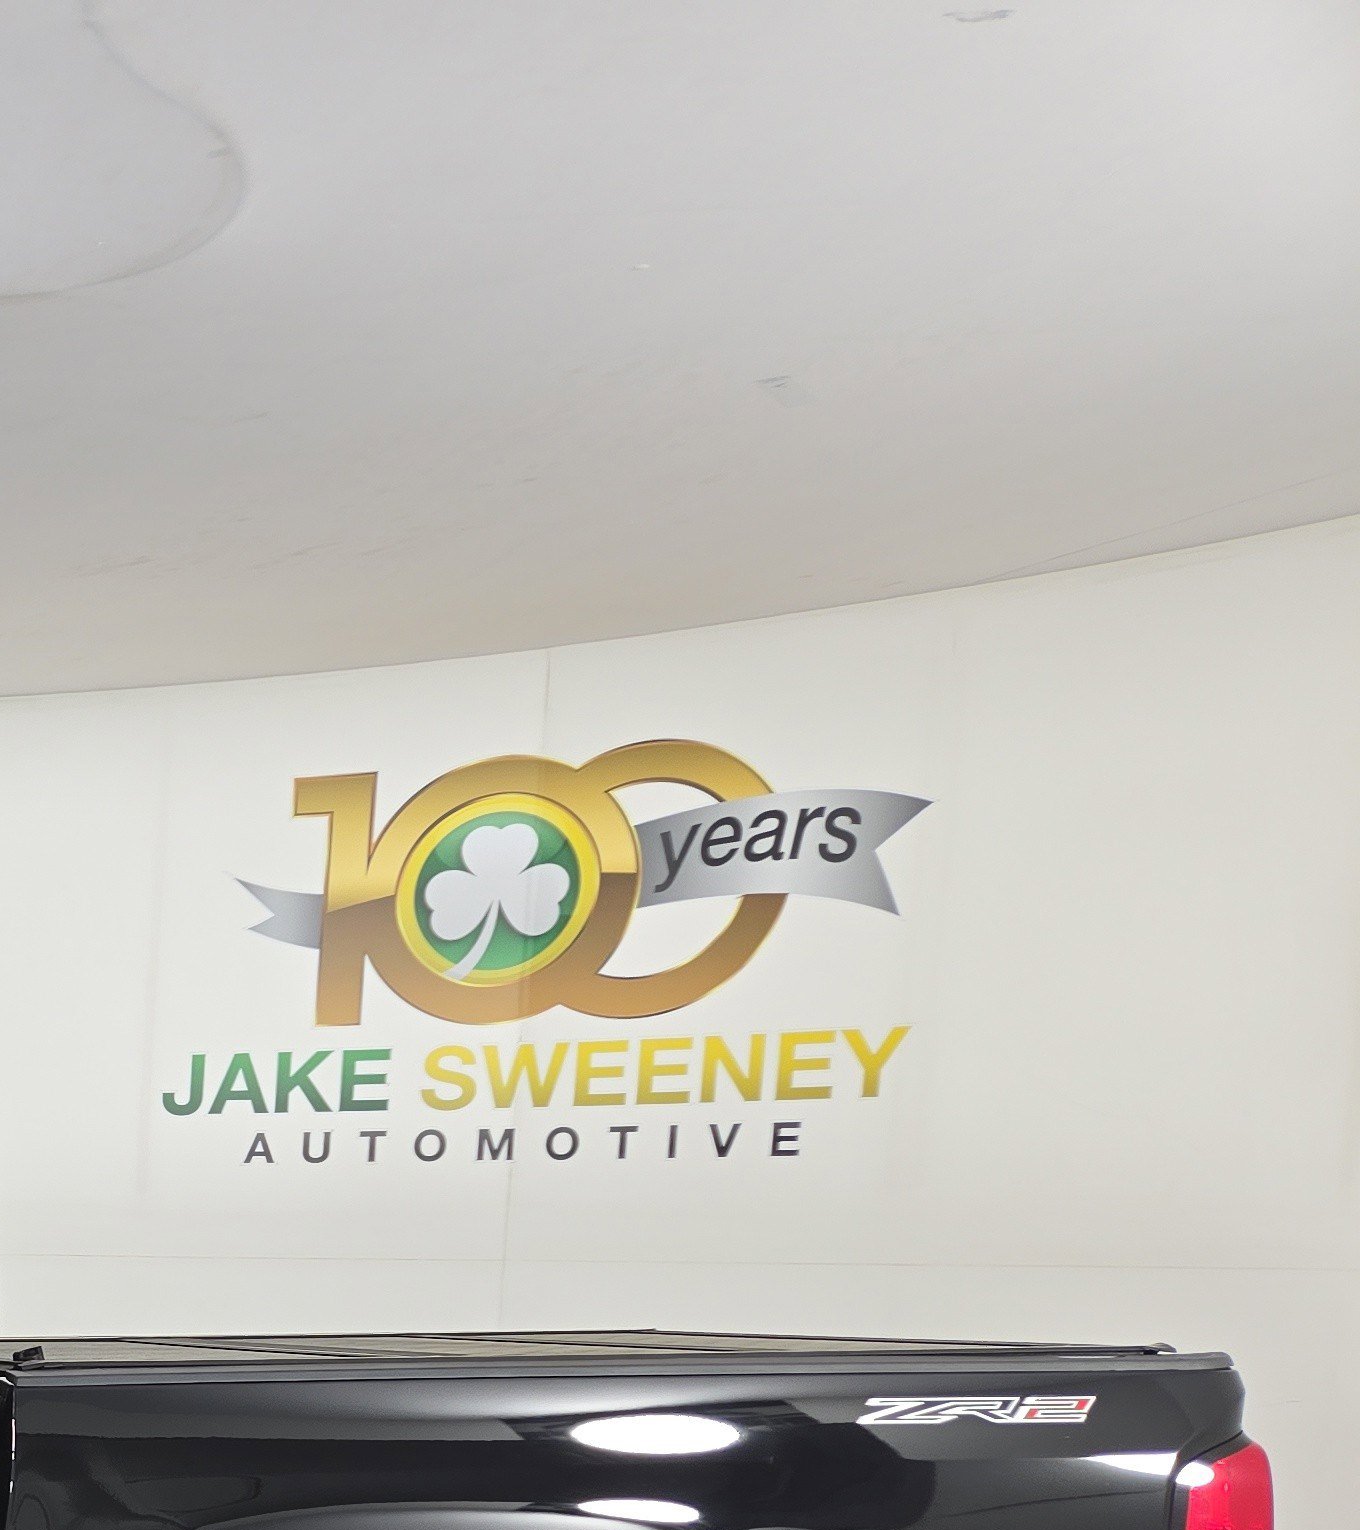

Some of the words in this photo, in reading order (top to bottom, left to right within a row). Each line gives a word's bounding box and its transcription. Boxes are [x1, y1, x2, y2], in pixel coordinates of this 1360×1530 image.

[292, 737, 790, 1028] 100
[652, 800, 863, 893] years
[161, 1046, 391, 1117] JAKE
[420, 1024, 913, 1113] SWEENEY
[243, 1120, 803, 1166] AUTOMOTIVE
[855, 1395, 1097, 1425] ZR2
